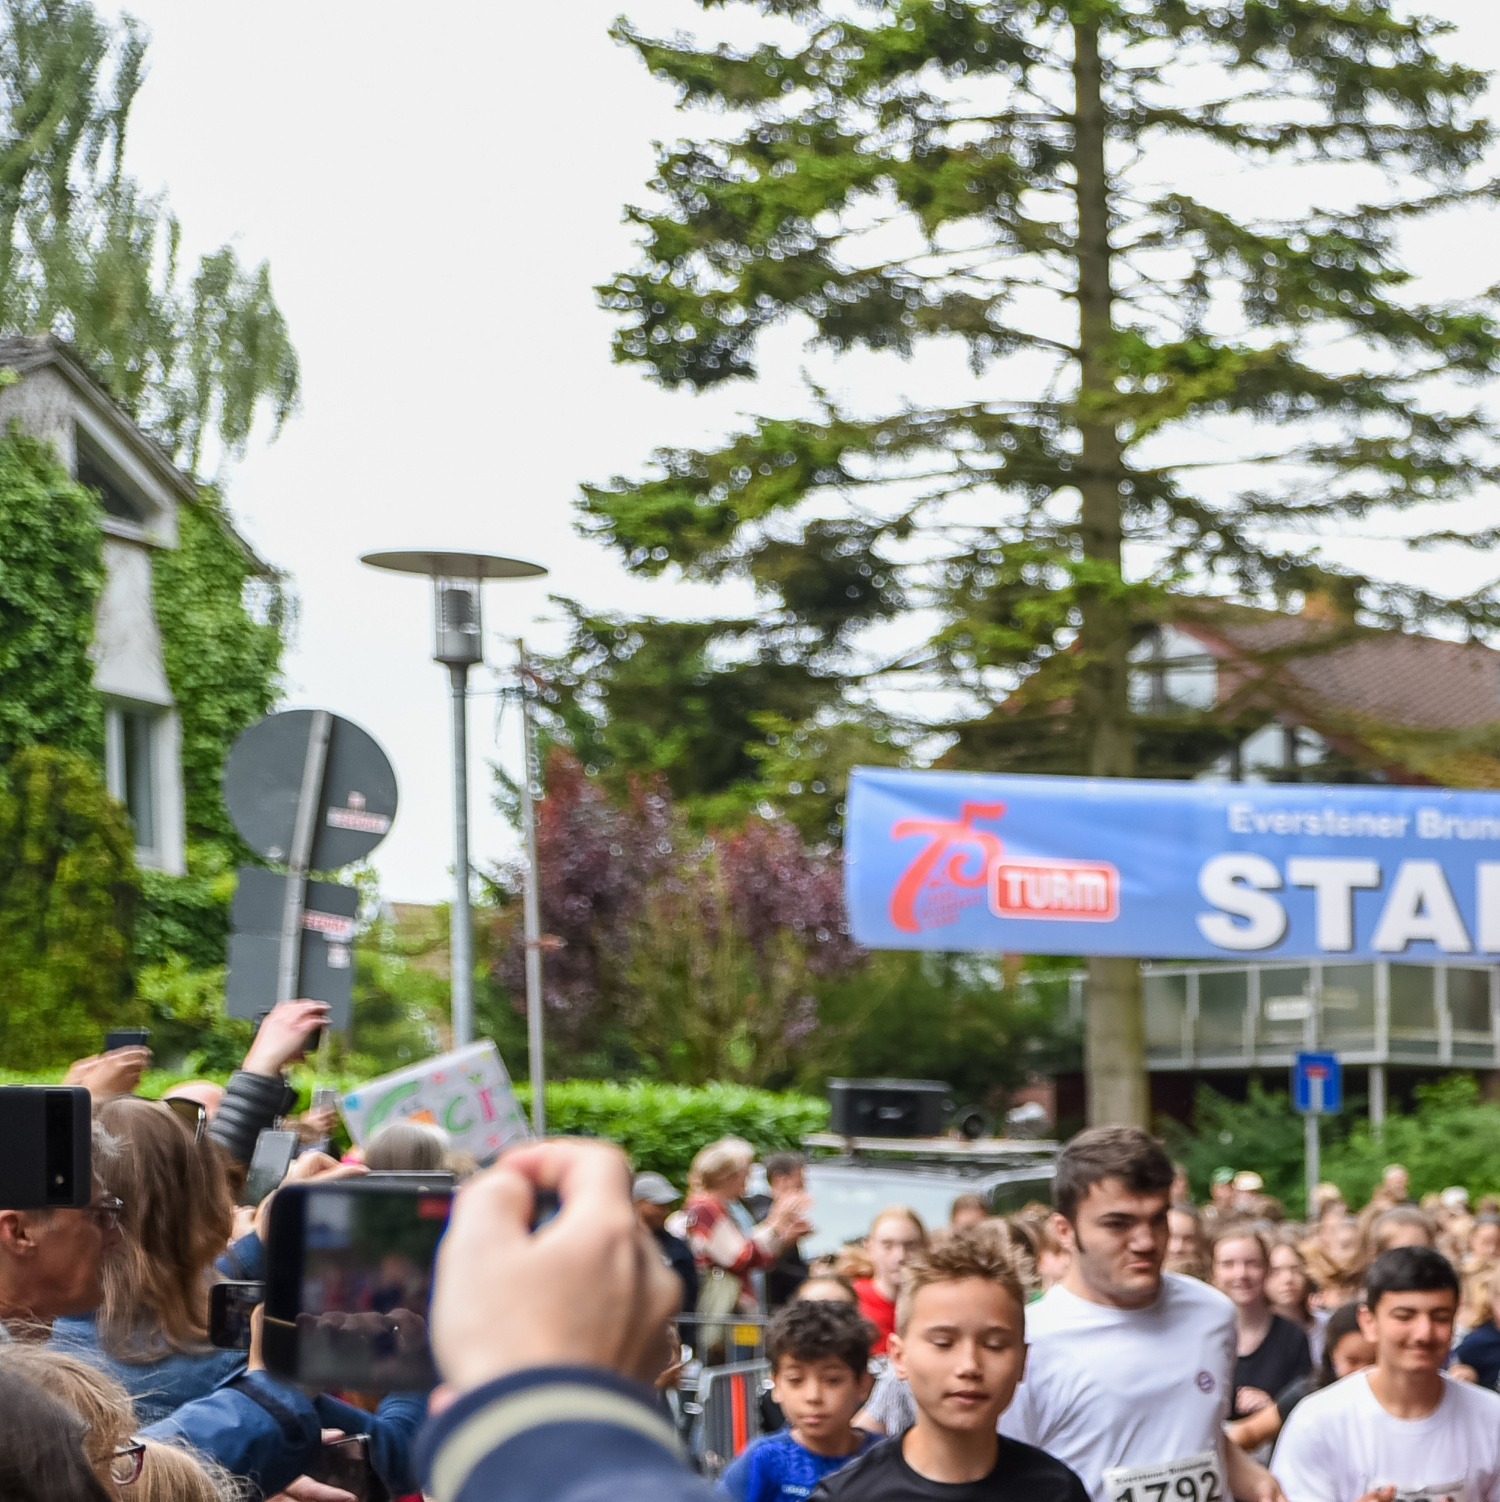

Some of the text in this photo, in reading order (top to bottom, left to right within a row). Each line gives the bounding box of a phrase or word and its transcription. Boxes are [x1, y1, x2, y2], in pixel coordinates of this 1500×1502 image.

[1228, 804, 1407, 838] Everstener
[890, 802, 1006, 932] 75
[1002, 868, 1108, 910] TURM
